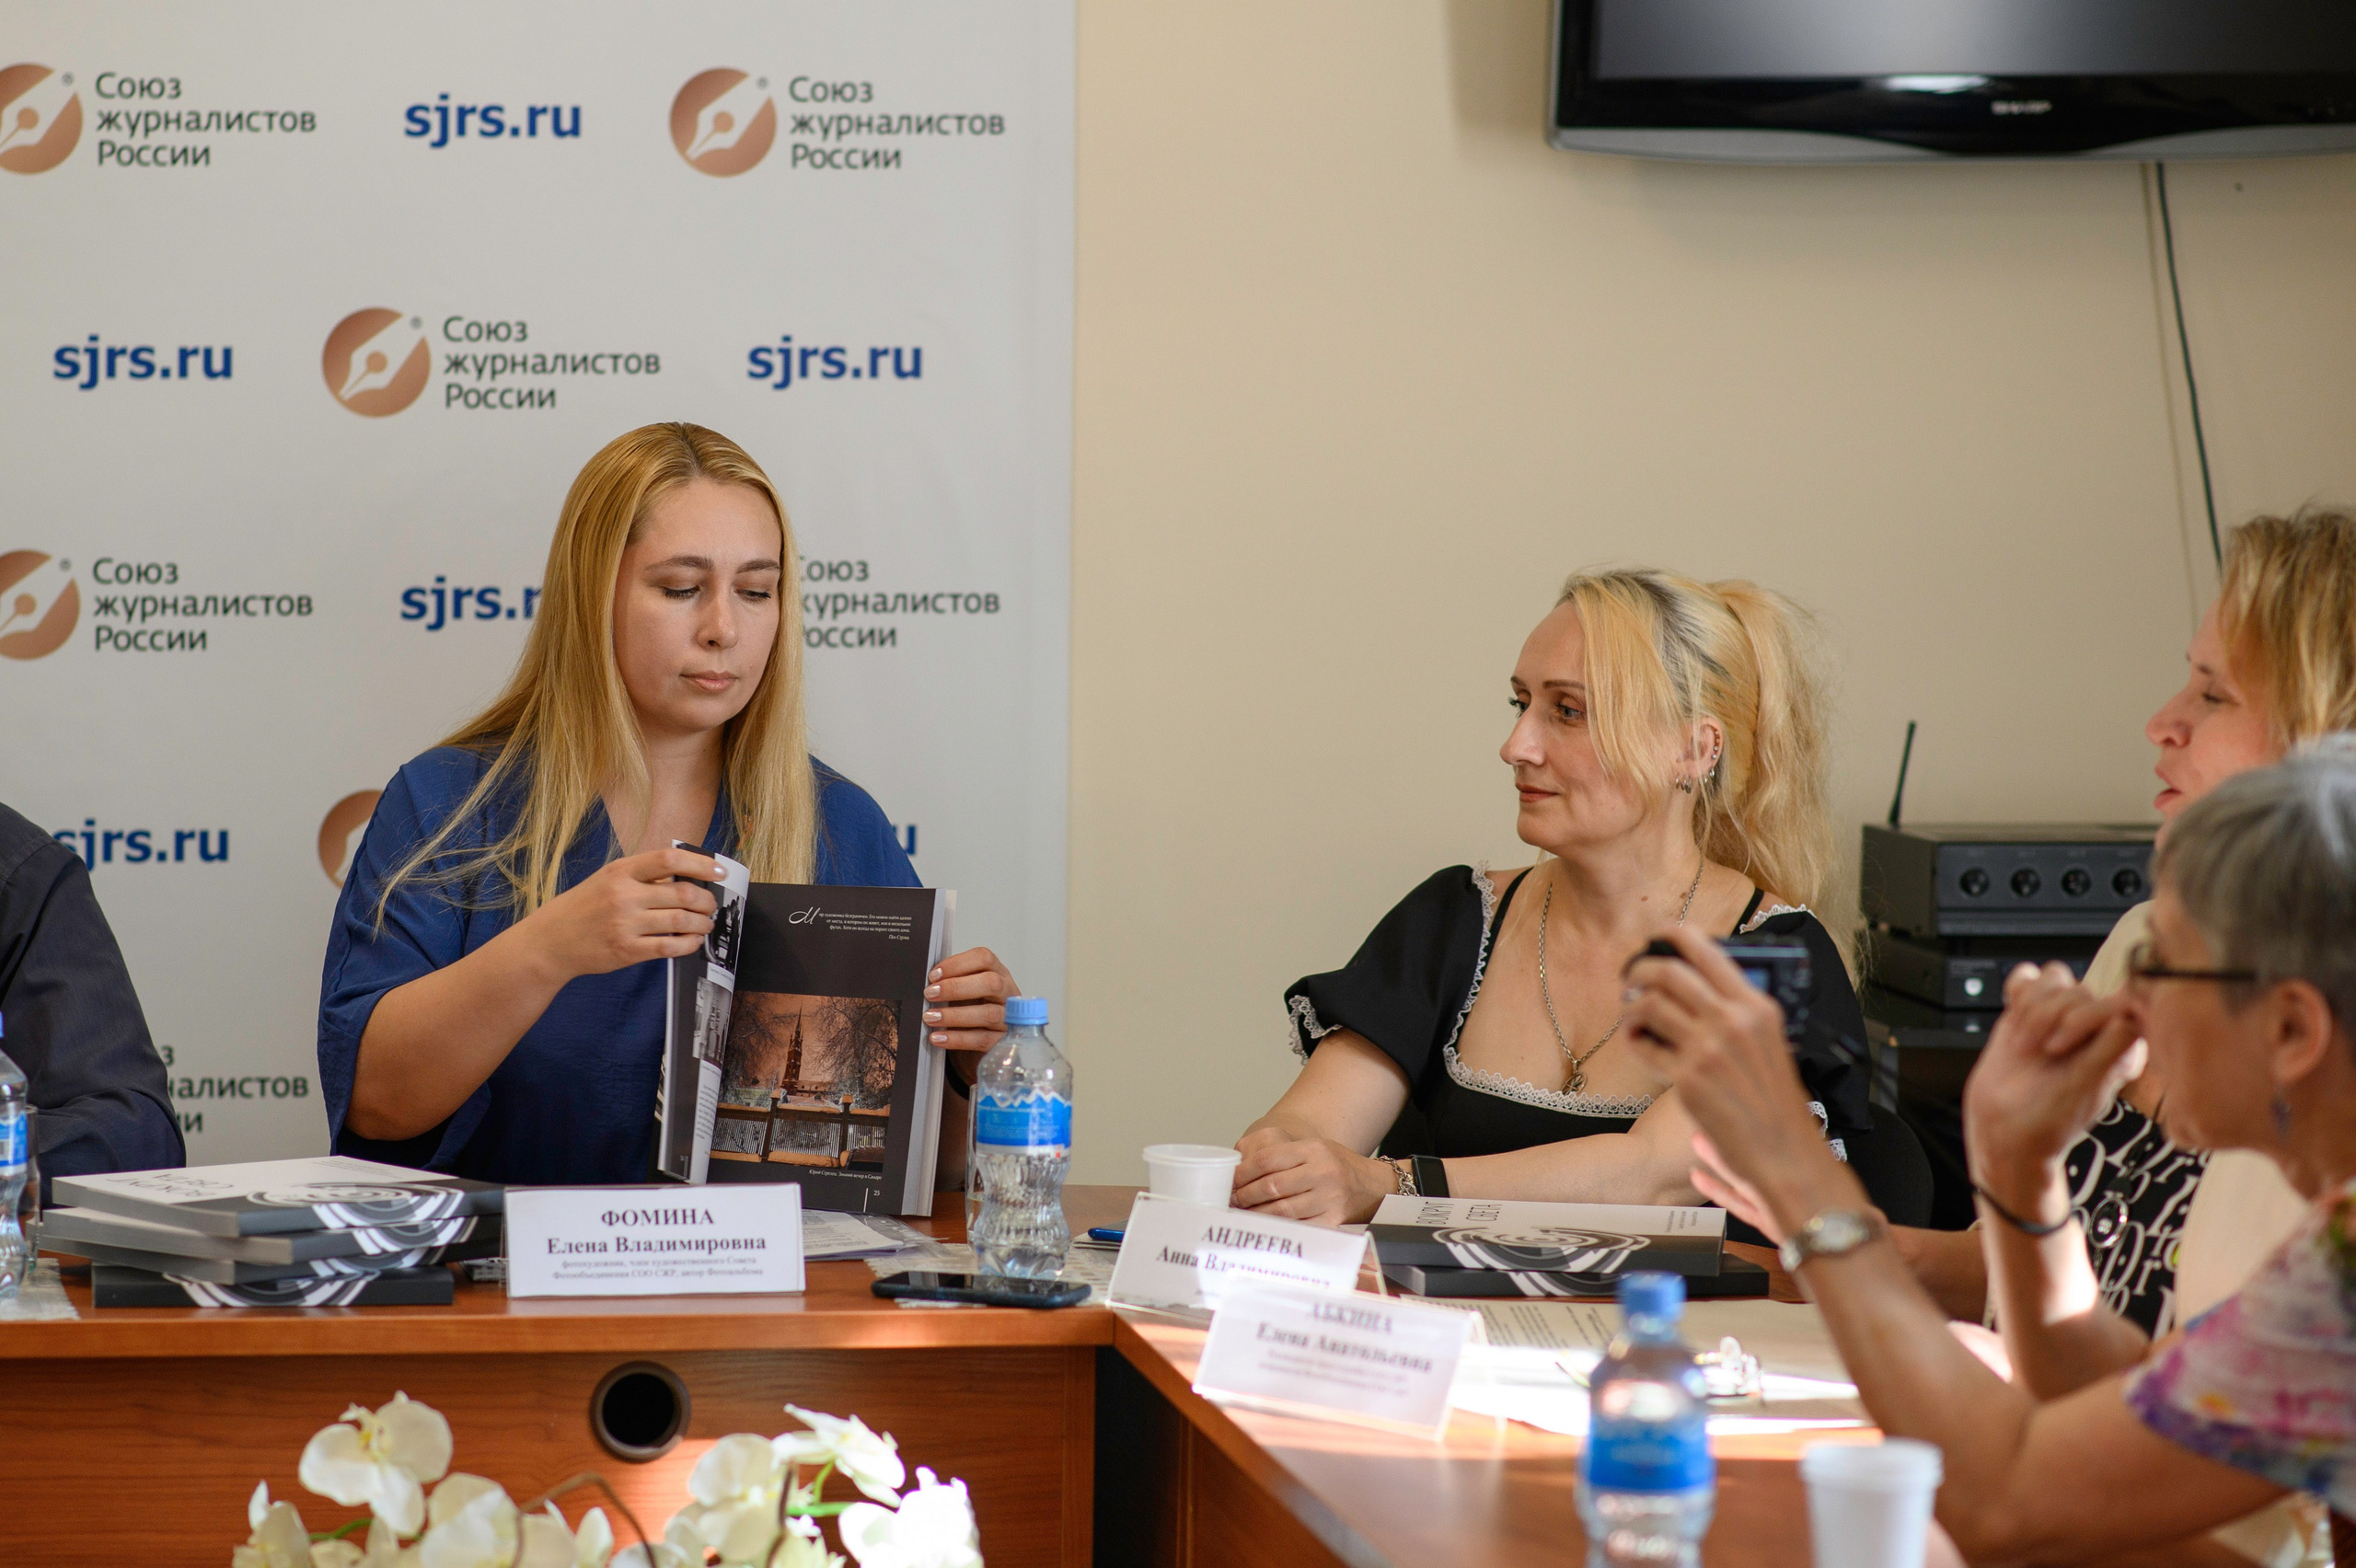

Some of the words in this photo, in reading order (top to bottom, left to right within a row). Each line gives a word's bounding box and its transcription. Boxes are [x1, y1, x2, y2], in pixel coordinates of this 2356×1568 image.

[95, 72, 182, 99] Союз
[789, 75, 873, 103] Союз
[97, 110, 317, 133] журналистов
[405, 93, 582, 148] sjrs.ru
[791, 114, 1005, 139] журналистов
[98, 139, 211, 167] России
[791, 144, 902, 169] России
[443, 317, 528, 343] Союз
[53, 334, 234, 390] sjrs.ru
[444, 352, 661, 378] журналистов
[747, 335, 923, 390] sjrs.ru
[445, 384, 557, 409] России
[93, 558, 179, 585] Союз
[94, 594, 313, 621] журналистов
[400, 575, 542, 631] sjrs.r
[95, 626, 207, 652] России
[803, 626, 896, 649] оссии
[601, 1208, 715, 1227] ФОМИНА
[1465, 1204, 1503, 1222] СВЕТА
[547, 1237, 608, 1255] Елена
[615, 1236, 767, 1256] Владимировна
[1200, 1226, 1305, 1259] АНДРЕЕВА
[1156, 1245, 1198, 1267] Анна
